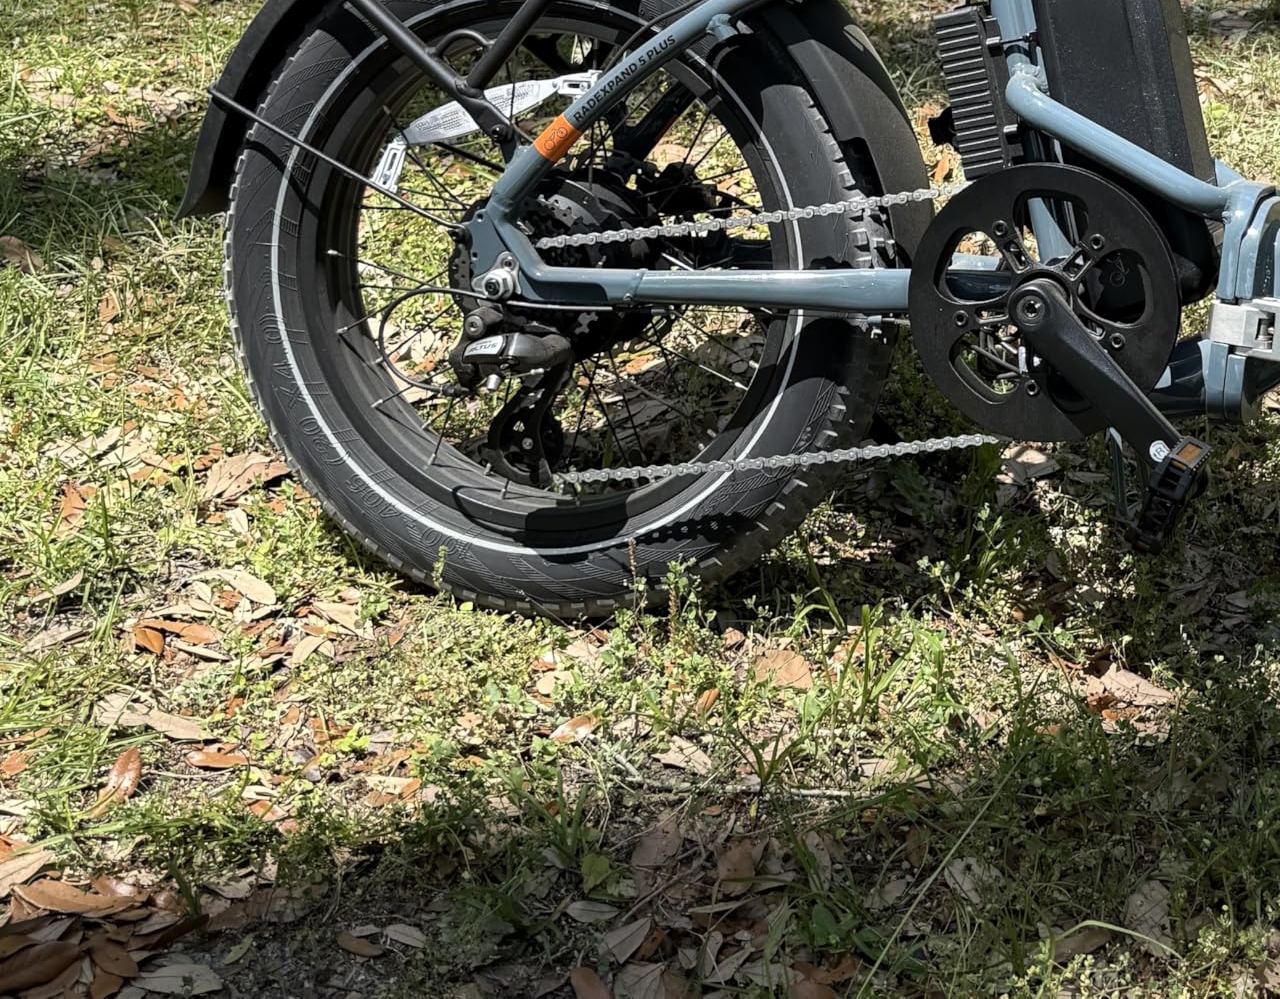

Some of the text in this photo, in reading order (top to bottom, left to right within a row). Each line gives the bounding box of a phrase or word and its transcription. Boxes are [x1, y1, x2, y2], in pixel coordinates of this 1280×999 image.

[573, 35, 676, 122] RADEXPAND 5 PLUS
